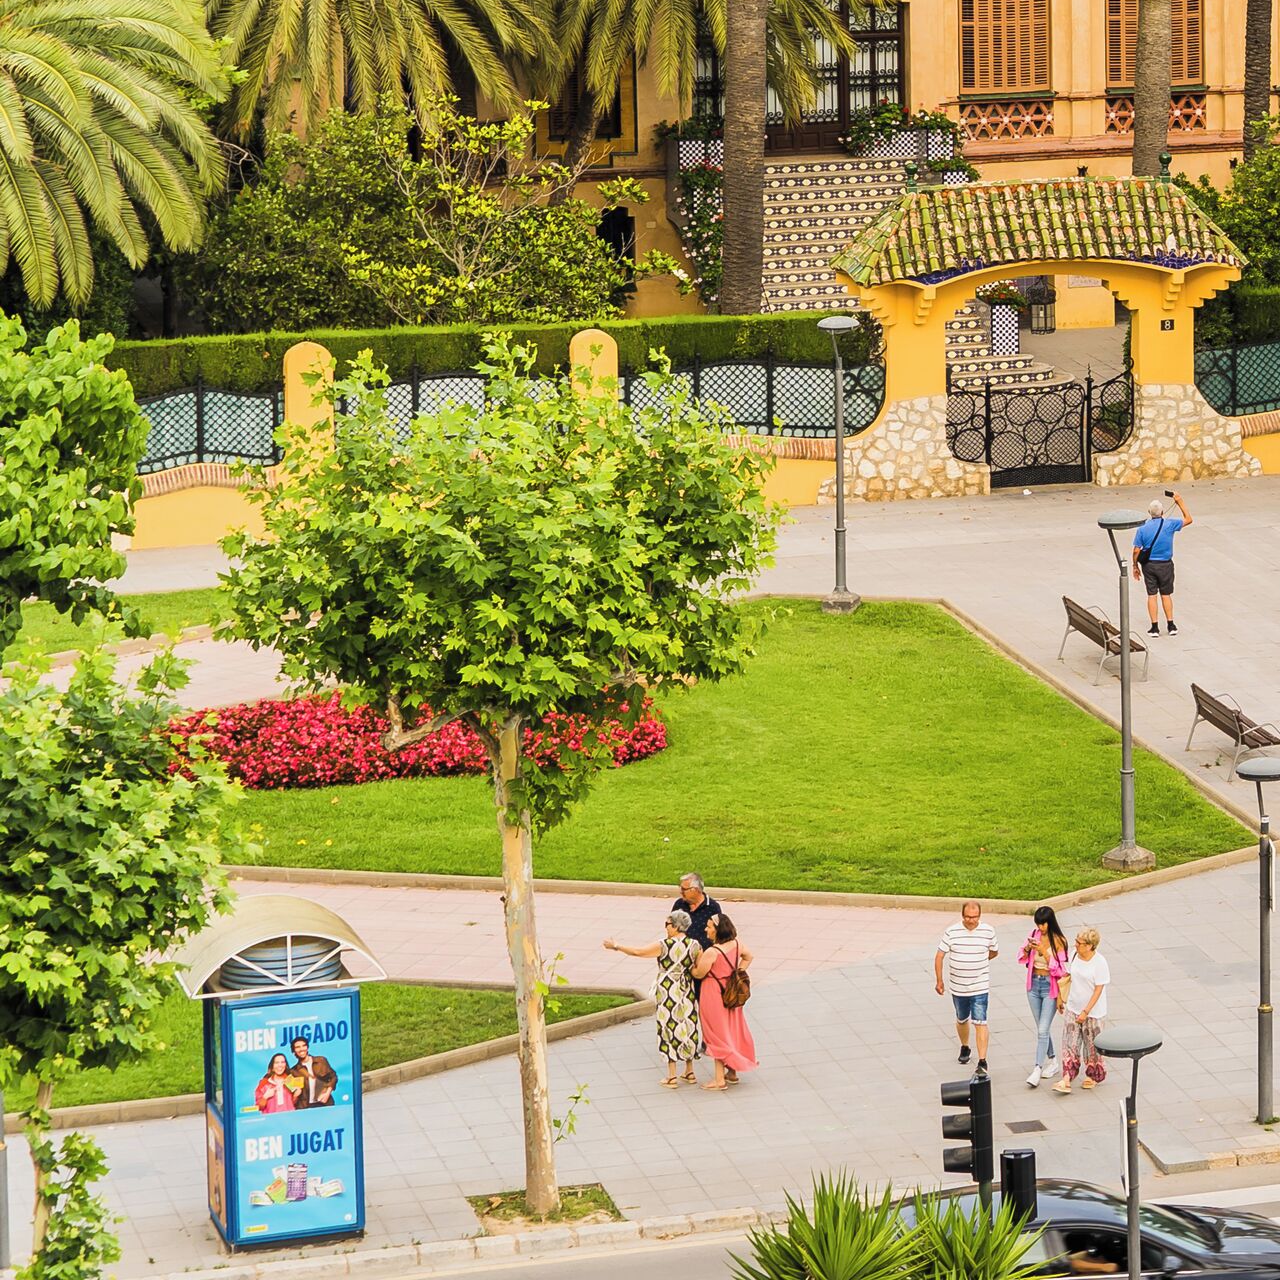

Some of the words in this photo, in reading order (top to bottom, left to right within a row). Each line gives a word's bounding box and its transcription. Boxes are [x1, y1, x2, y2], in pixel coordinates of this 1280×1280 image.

[1164, 320, 1171, 330] 8
[235, 1027, 276, 1053] BIEN
[280, 1020, 348, 1047] JUGADO
[245, 1135, 283, 1162] BEN
[287, 1128, 345, 1156] JUGAT
